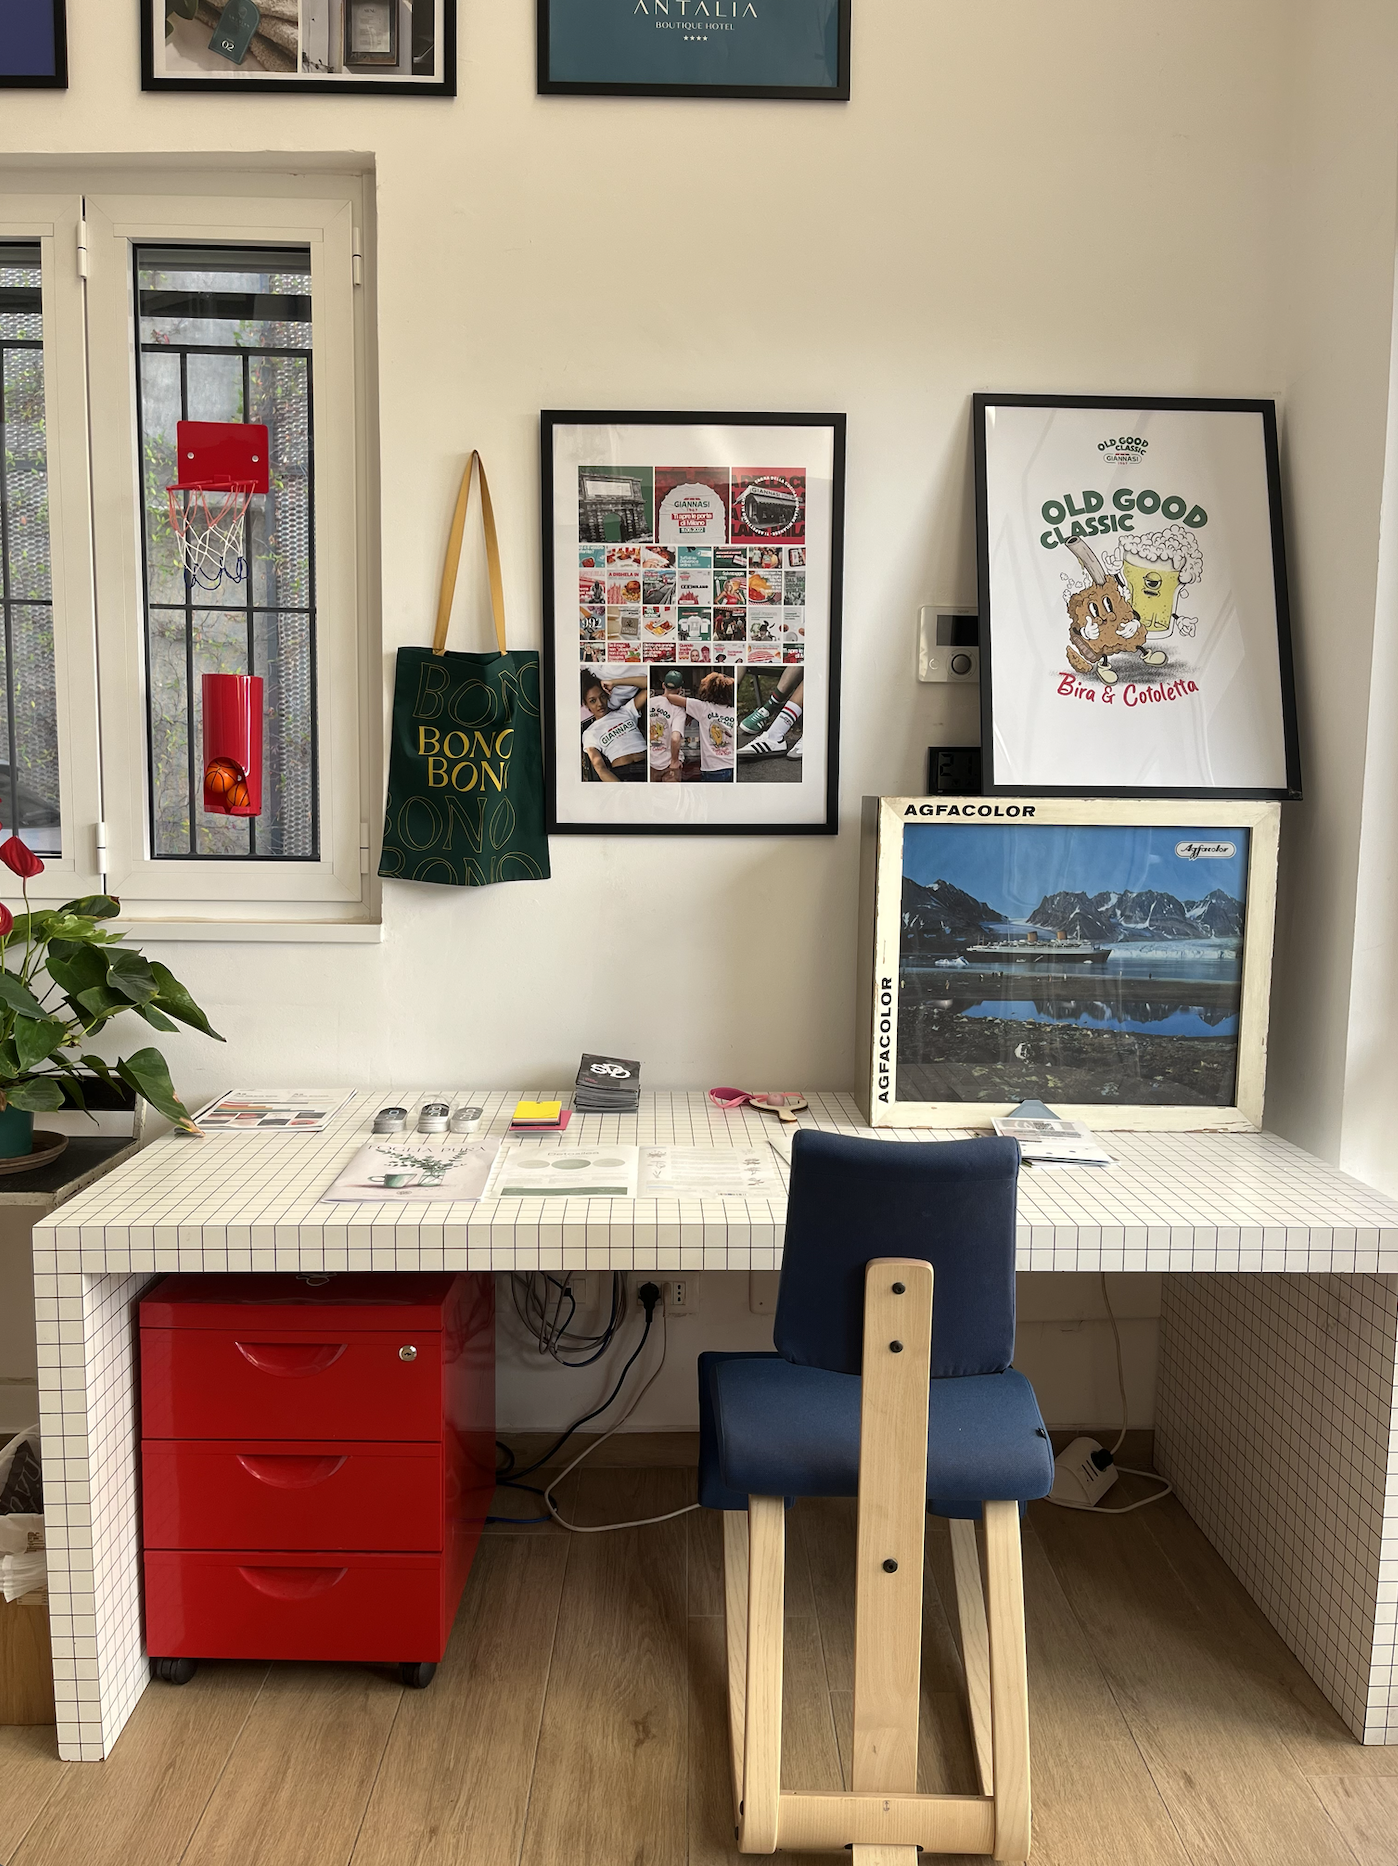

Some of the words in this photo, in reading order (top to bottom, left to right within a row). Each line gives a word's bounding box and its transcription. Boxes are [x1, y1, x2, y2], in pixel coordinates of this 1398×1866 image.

[633, 0, 758, 18] ANTALIA
[655, 21, 702, 31] BOUTIQUE
[705, 22, 735, 31] HOTEL
[221, 40, 235, 52] 02
[1097, 438, 1116, 451] OLD
[1118, 436, 1149, 448] GOOD
[1115, 445, 1147, 456] CLASSIC
[674, 500, 710, 508] GIANNASI
[1041, 490, 1104, 525] OLD
[1112, 488, 1208, 528] GOOD
[1040, 513, 1135, 550] CLASSIC
[1057, 672, 1096, 703] Bira
[1101, 685, 1116, 705] &
[427, 757, 511, 792] BON
[904, 804, 1036, 817] AGFACOLOR
[1180, 843, 1229, 859] Agfacolor
[878, 977, 892, 1104] AGFACOLOR
